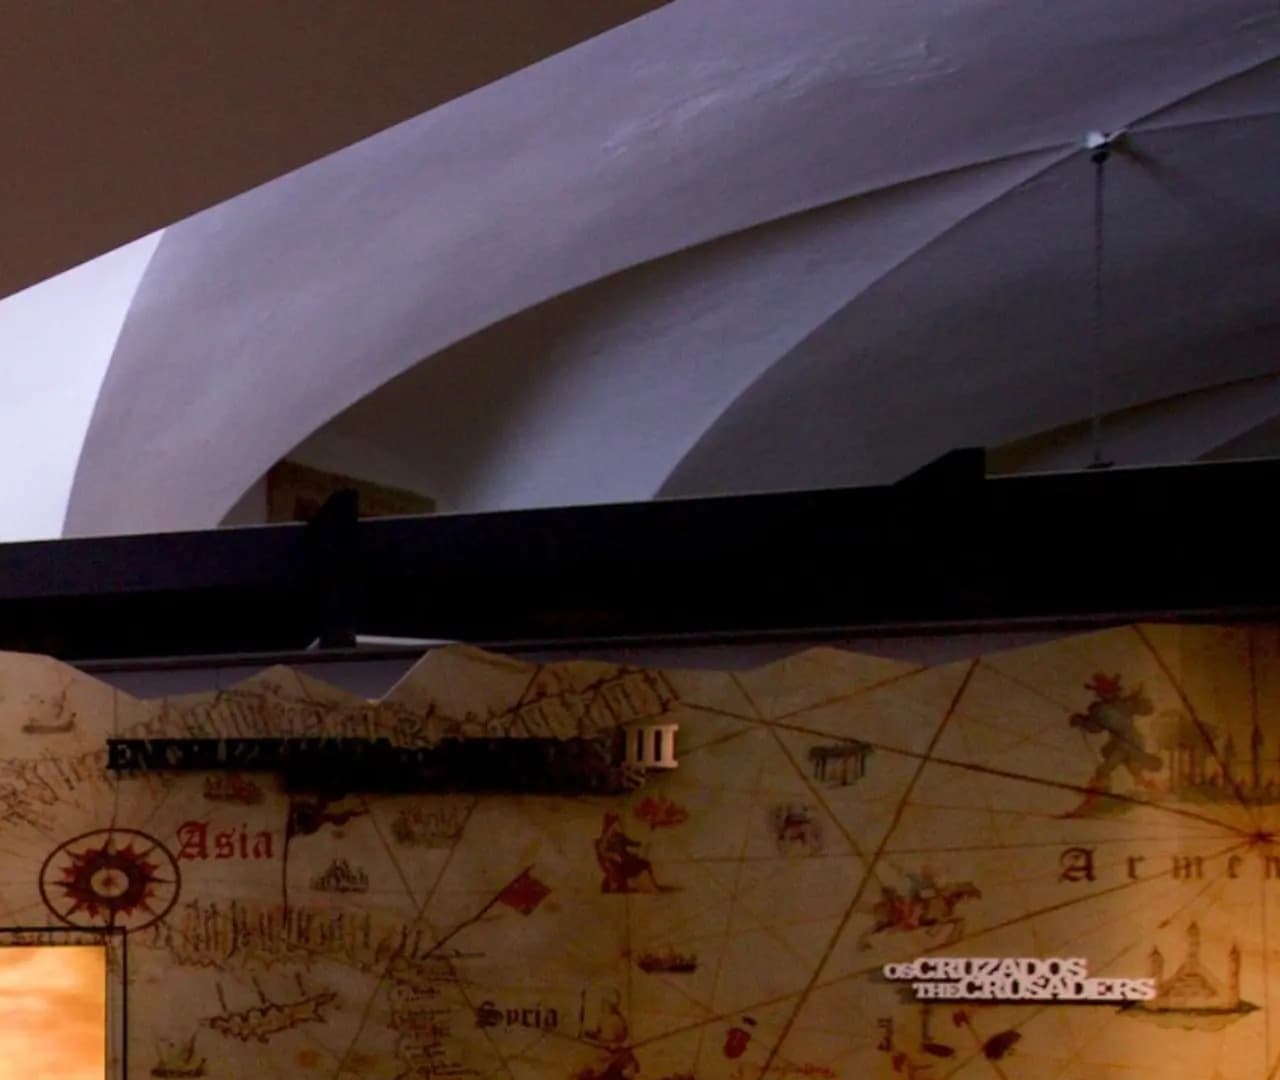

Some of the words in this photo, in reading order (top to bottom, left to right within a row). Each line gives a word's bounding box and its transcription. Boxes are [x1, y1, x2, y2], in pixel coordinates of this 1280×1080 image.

[175, 819, 275, 863] Asia
[912, 957, 1088, 981] CRUZADOS
[959, 977, 1157, 1000] CRUSADERS
[475, 1000, 558, 1032] Syria
